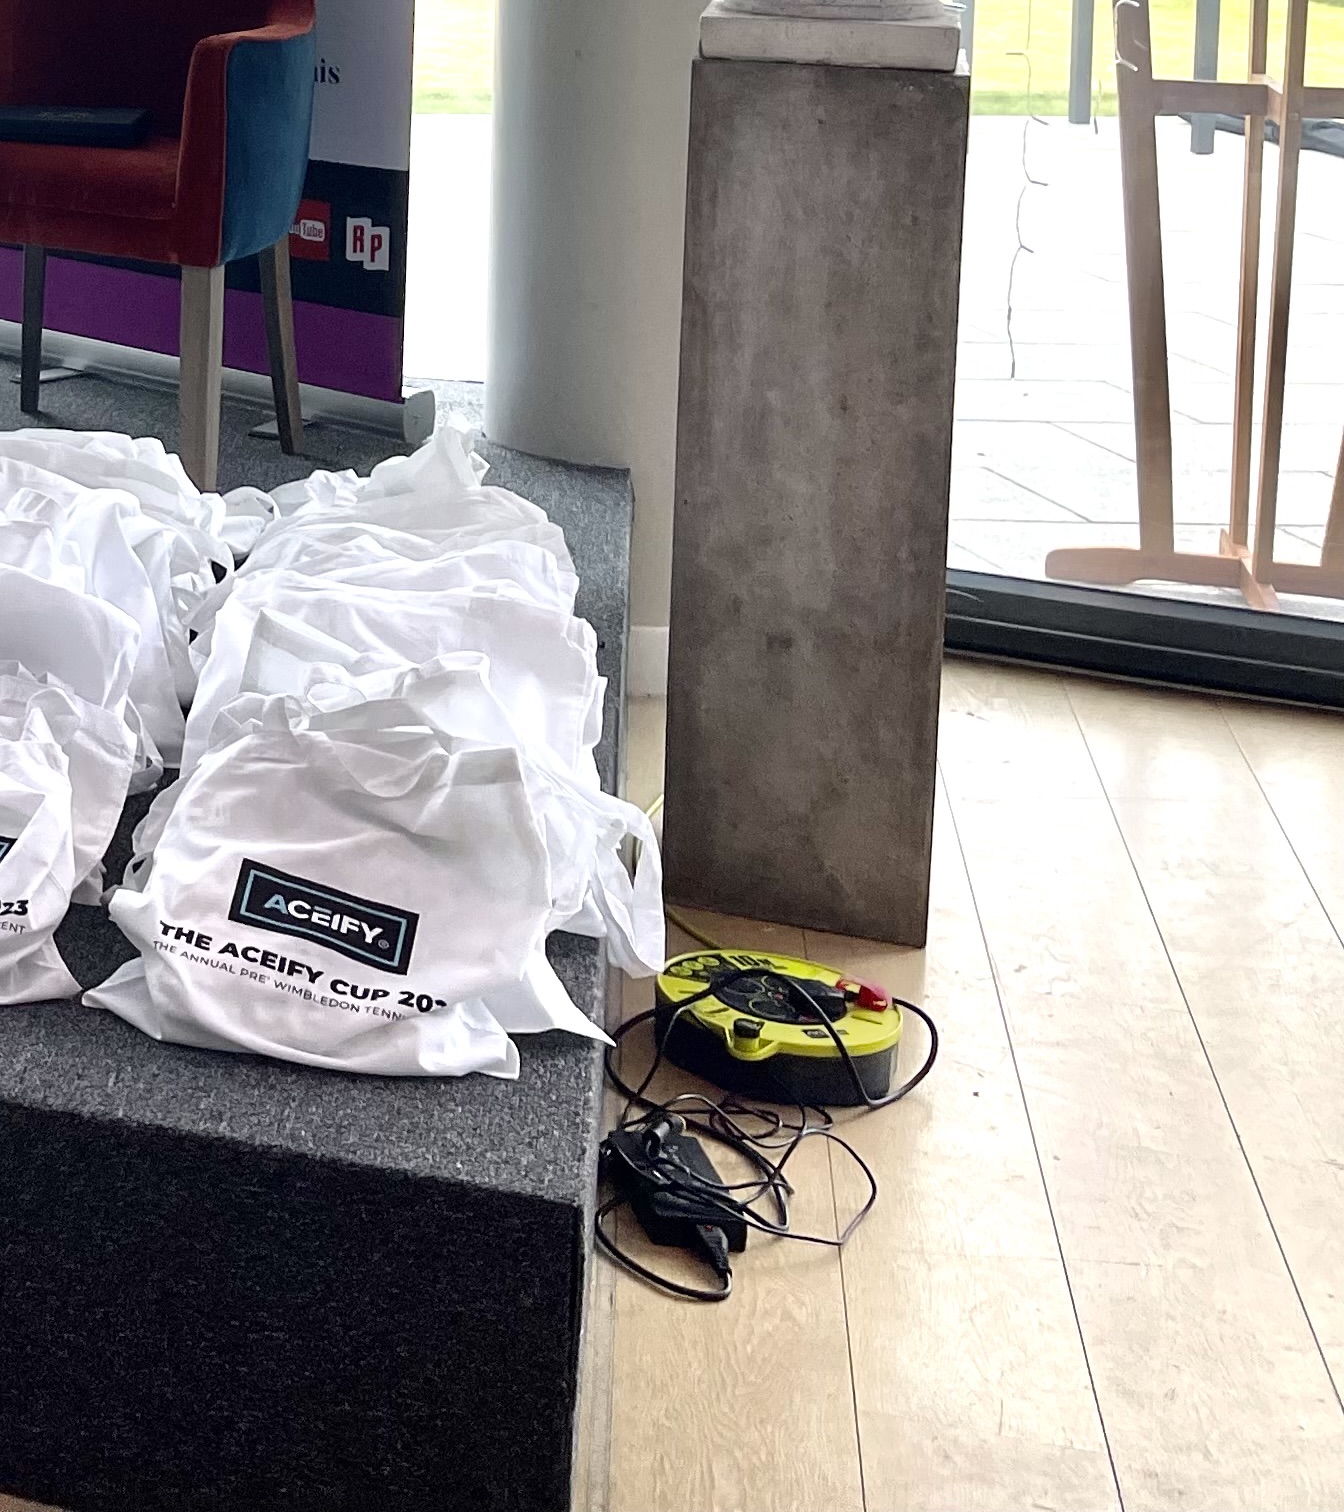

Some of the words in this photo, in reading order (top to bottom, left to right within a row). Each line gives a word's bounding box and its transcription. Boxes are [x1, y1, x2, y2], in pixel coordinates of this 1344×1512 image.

[263, 893, 384, 944] ACEIFY
[153, 941, 178, 954] THE
[180, 950, 236, 975] ANNUAL
[274, 980, 360, 1013] WIMBLEDON
[159, 920, 212, 950] THE
[218, 942, 324, 984] ACEIFY
[330, 979, 390, 1002] CUP
